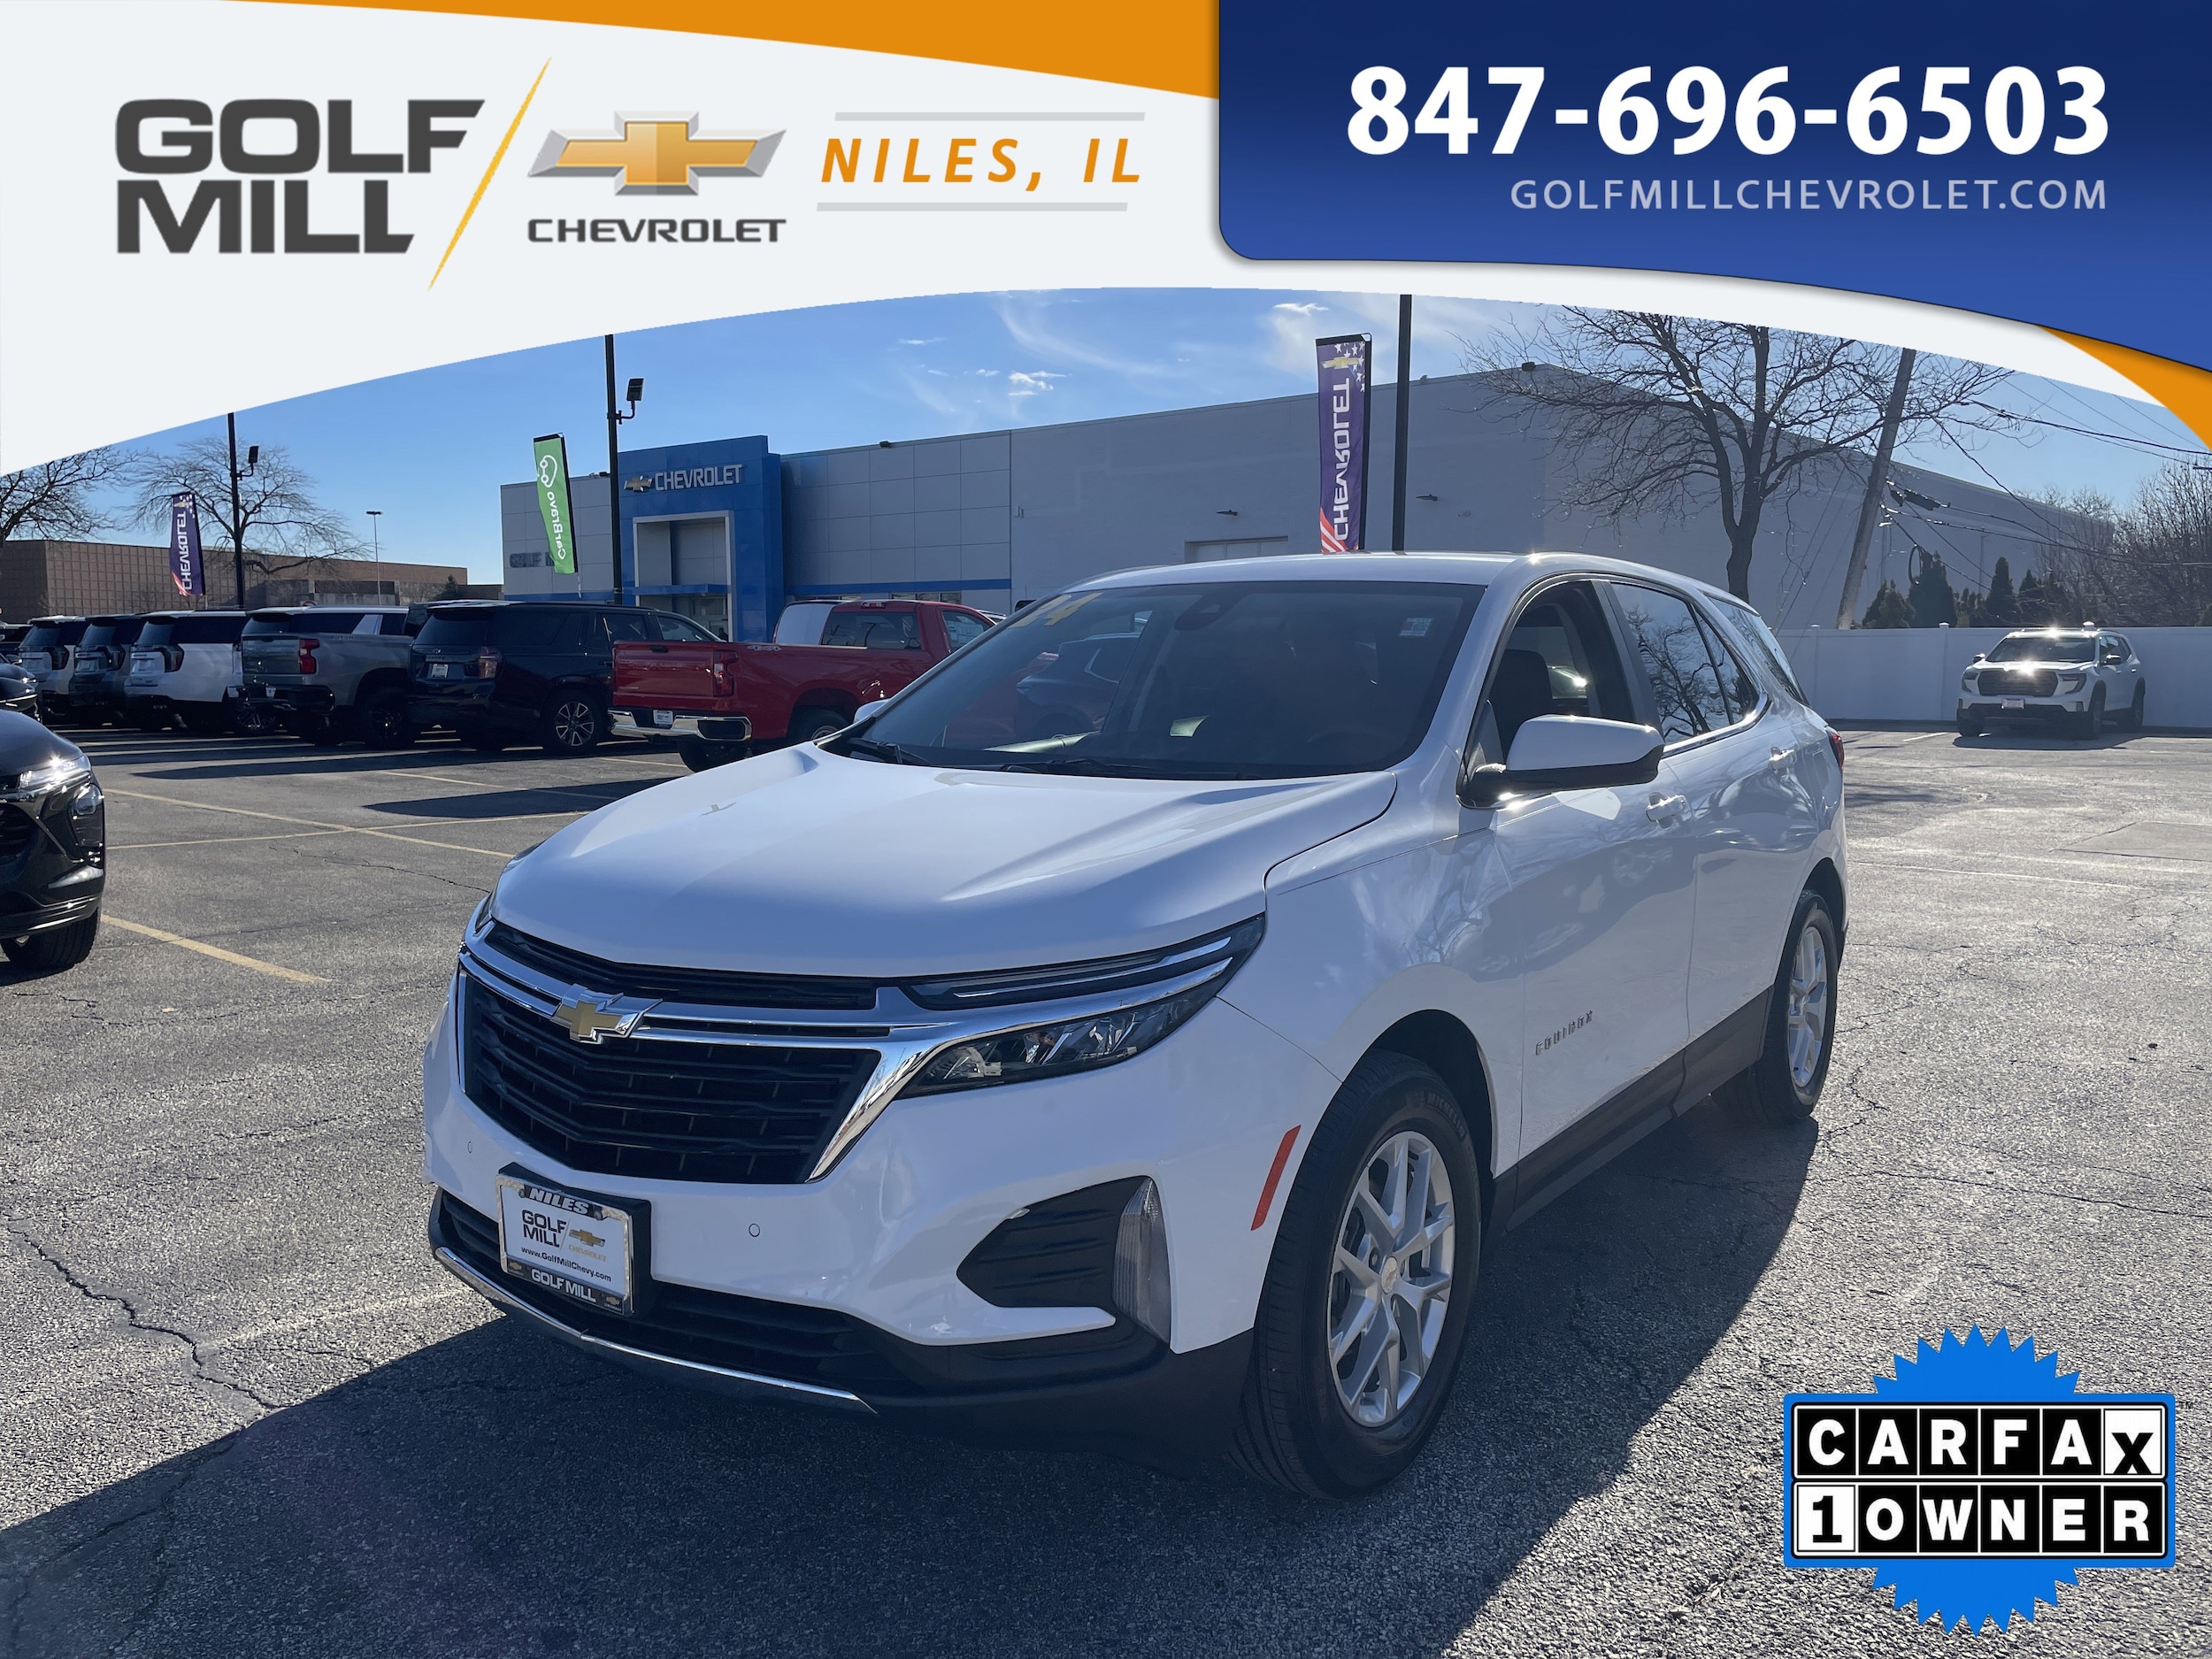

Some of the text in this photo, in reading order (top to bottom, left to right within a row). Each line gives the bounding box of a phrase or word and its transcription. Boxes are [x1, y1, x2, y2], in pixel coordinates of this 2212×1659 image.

[655, 465, 742, 491] CHEVROLET
[1535, 1010, 1594, 1056] EQUINOX
[529, 1187, 589, 1215] NILES
[522, 1210, 566, 1233] GOLF
[523, 1225, 560, 1248] MILL
[520, 1246, 612, 1282] www.GolfMillChevy.com
[531, 1268, 565, 1290] GOLF
[565, 1282, 596, 1302] MILL
